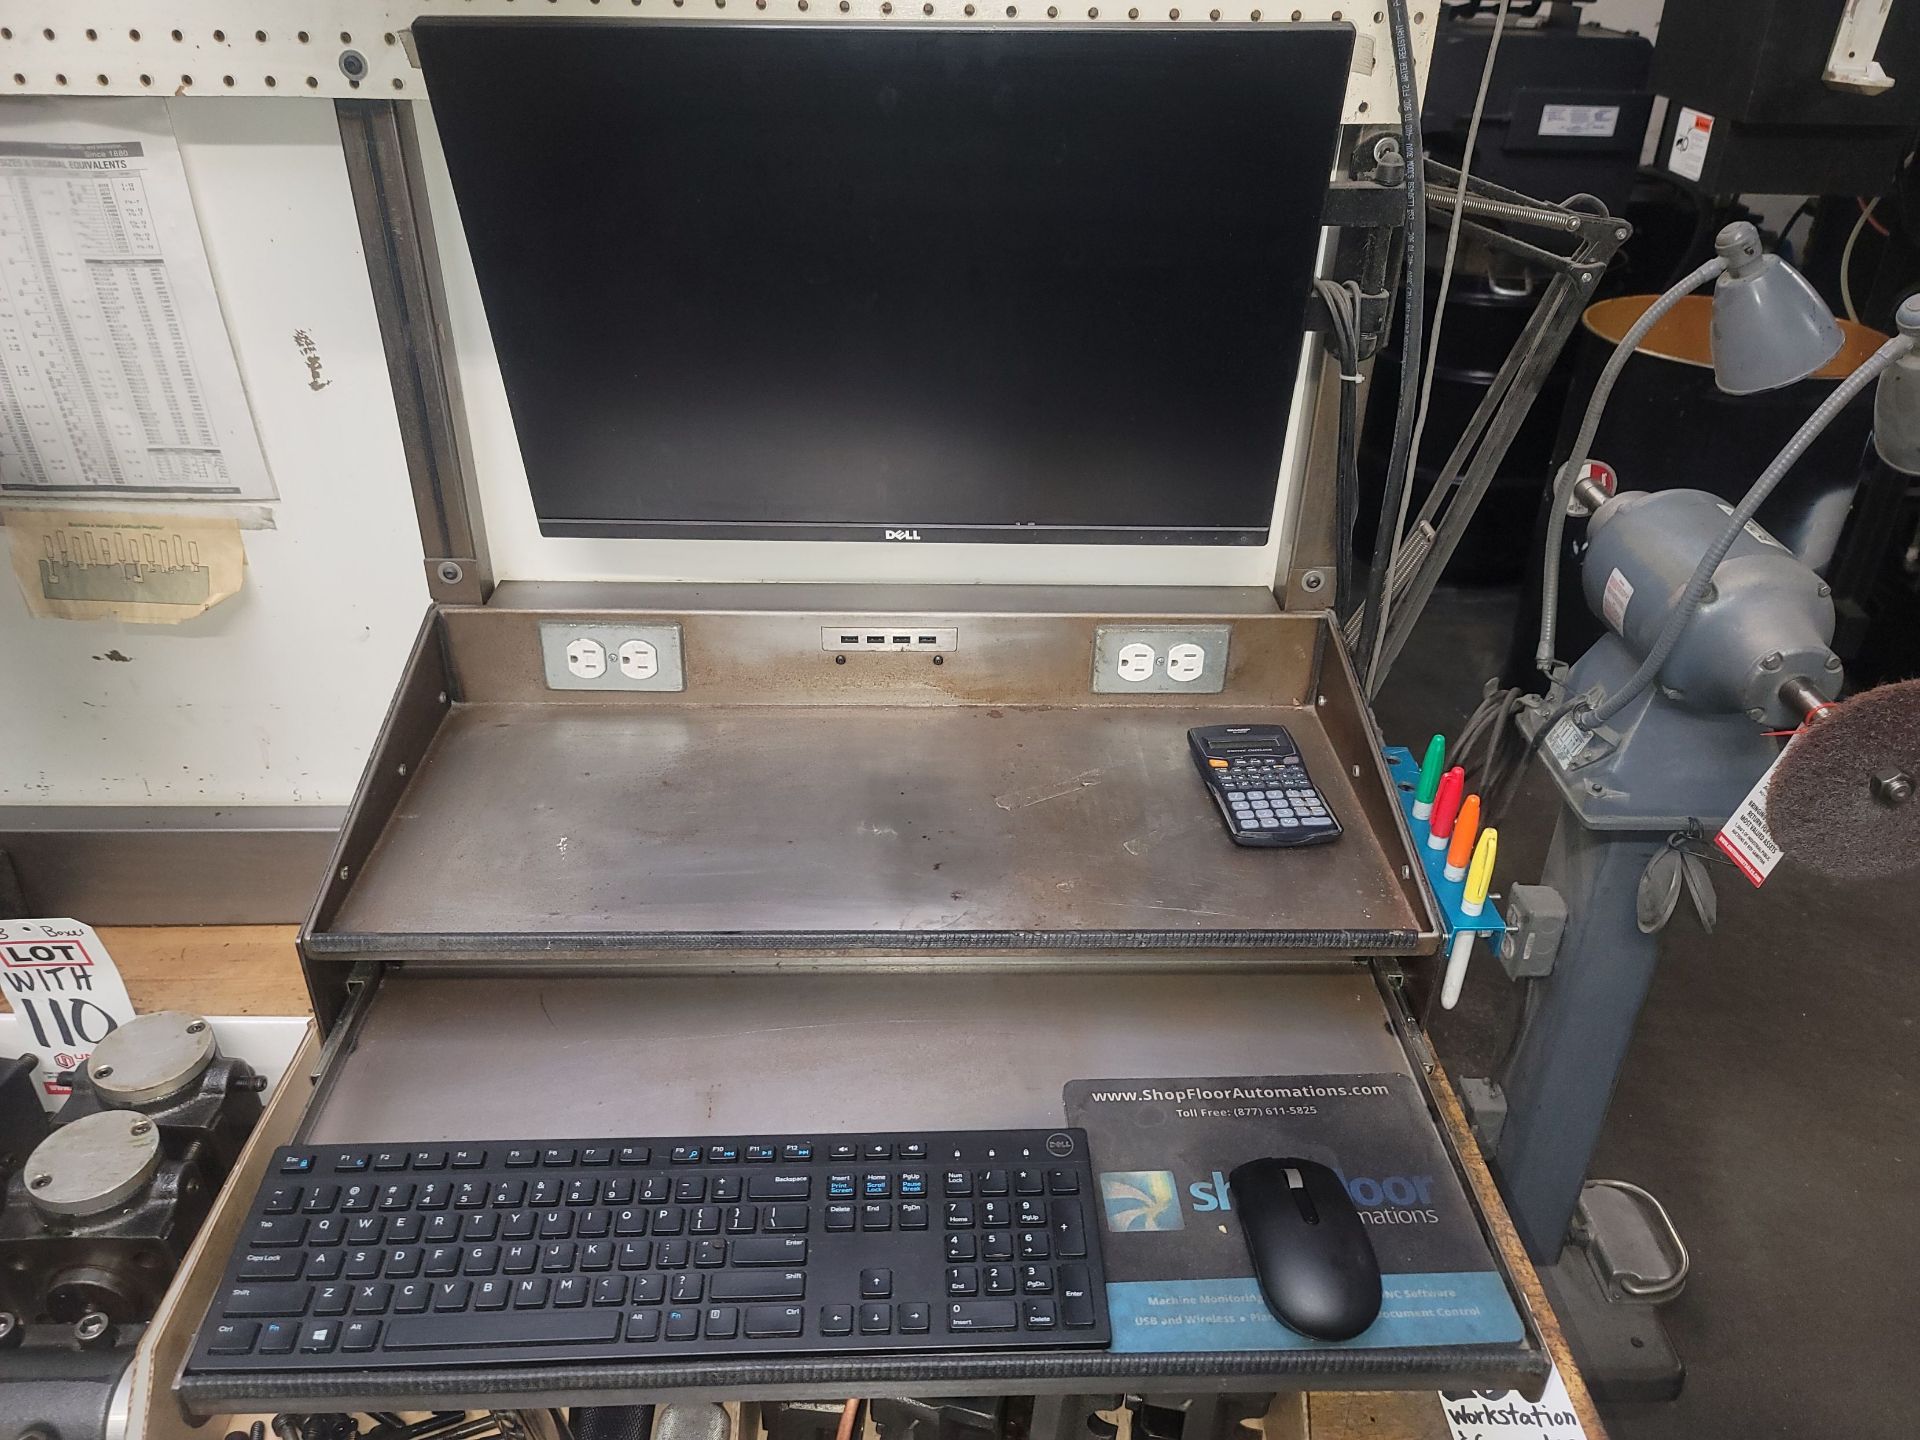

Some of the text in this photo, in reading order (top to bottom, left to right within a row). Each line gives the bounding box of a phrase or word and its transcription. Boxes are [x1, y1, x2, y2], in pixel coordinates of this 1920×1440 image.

[1396, 24, 1406, 59] RESISTANT
[1399, 62, 1409, 82] WATER
[1404, 113, 1413, 122] TO
[69, 160, 127, 169] EQUIVALENTS
[886, 530, 920, 540] DELL
[1740, 815, 1751, 827] MOST
[1763, 838, 1776, 853] ASSETS
[6, 945, 75, 962] LOT
[4, 965, 92, 993] WITH
[21, 998, 118, 1048] 110
[1092, 1083, 1389, 1103] www.ShopFloorAutomations.com
[1176, 1106, 1317, 1118] Toll Free: (877) 611-5825
[512, 1214, 520, 1222] Y
[660, 1210, 667, 1218] P
[319, 1220, 329, 1229] Q
[360, 1219, 372, 1227] W
[397, 1218, 406, 1226] E
[551, 1246, 559, 1254] J
[589, 1245, 597, 1253] K
[627, 1244, 633, 1252] L
[356, 1253, 365, 1261] S
[395, 1252, 405, 1260] D
[435, 1250, 443, 1258] F
[473, 1249, 481, 1257] G
[316, 1254, 325, 1262] A
[483, 1283, 492, 1291] B
[522, 1282, 532, 1290] N
[561, 1280, 572, 1288] M
[323, 1288, 334, 1297] Z
[363, 1287, 374, 1296] X
[404, 1286, 413, 1294] C
[445, 1284, 454, 1293] V
[1448, 1402, 1577, 1427] Workstation
